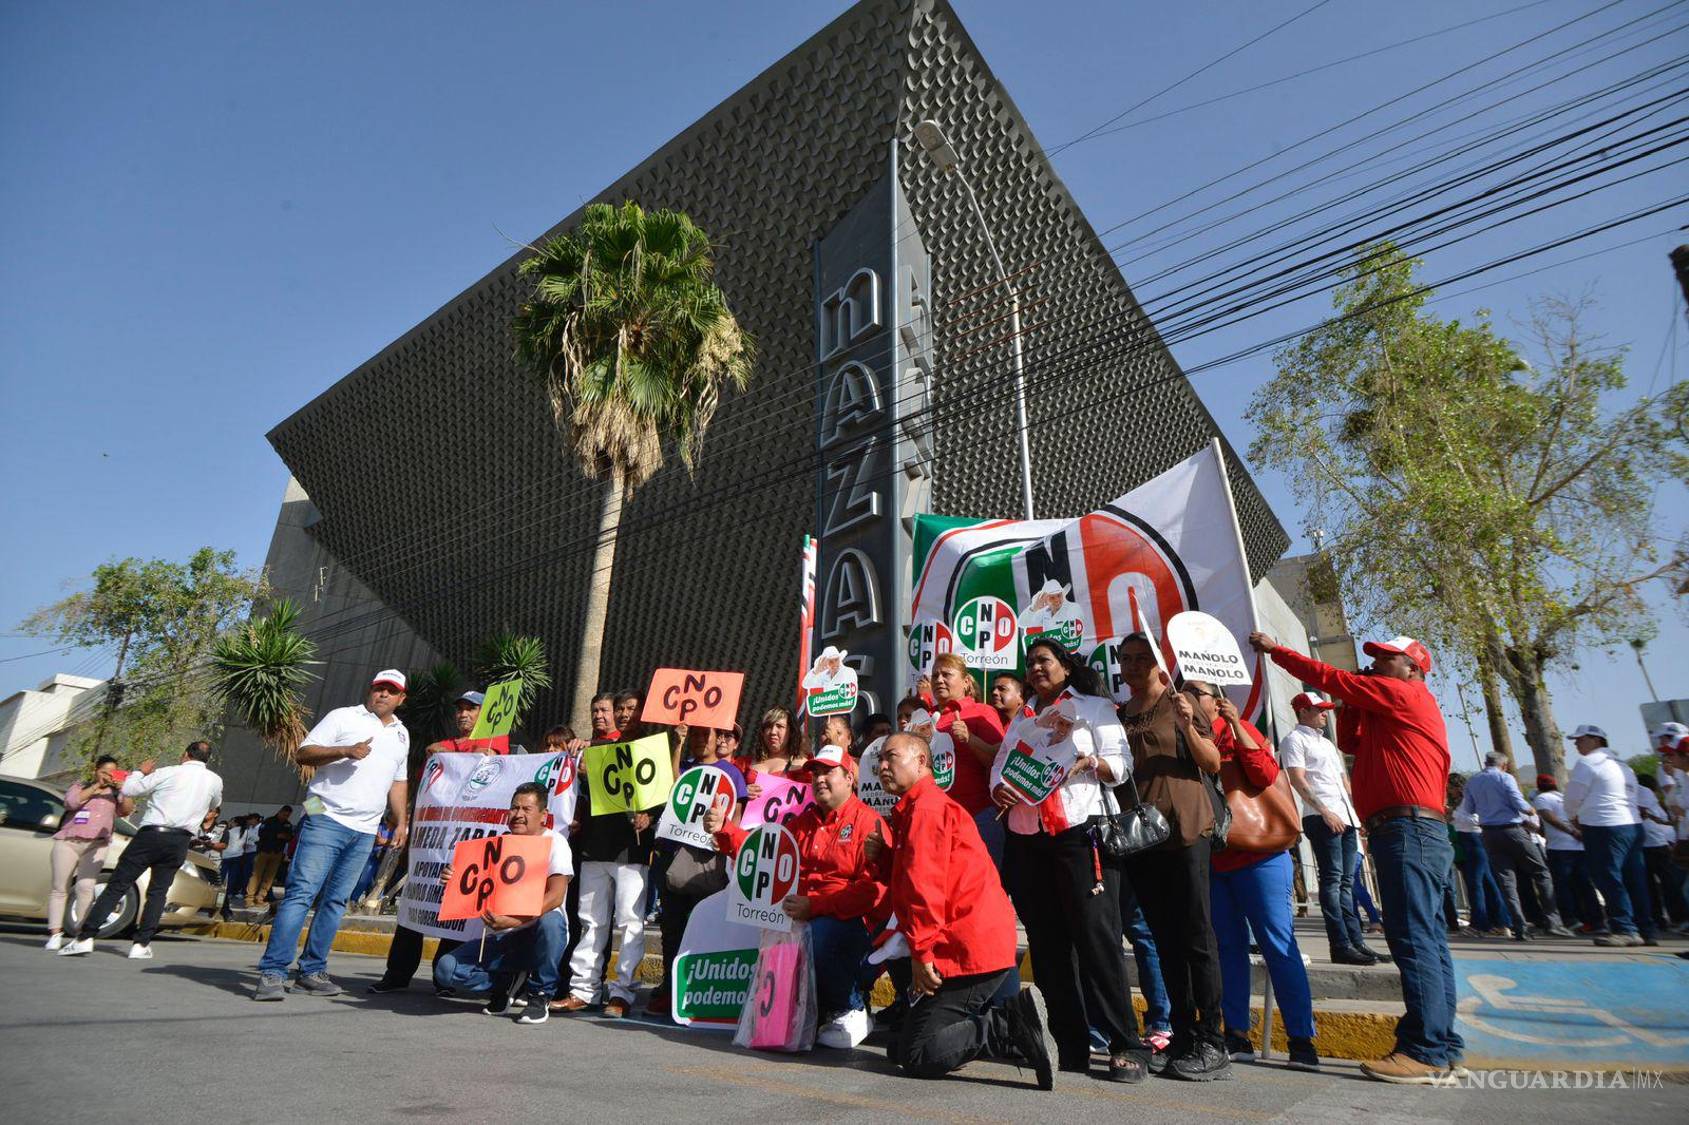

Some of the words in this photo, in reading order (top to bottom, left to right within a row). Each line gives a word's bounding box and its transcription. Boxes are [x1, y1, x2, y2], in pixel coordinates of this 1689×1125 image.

[961, 653, 1008, 665] Torreón
[1179, 650, 1238, 664] MANOLO
[1184, 665, 1244, 679] MANOLO
[813, 694, 838, 705] ¡Unidos
[812, 703, 838, 712] podemos
[1010, 756, 1040, 779] ¡Unidos
[1003, 767, 1033, 790] podemos
[737, 903, 785, 925] Torreón
